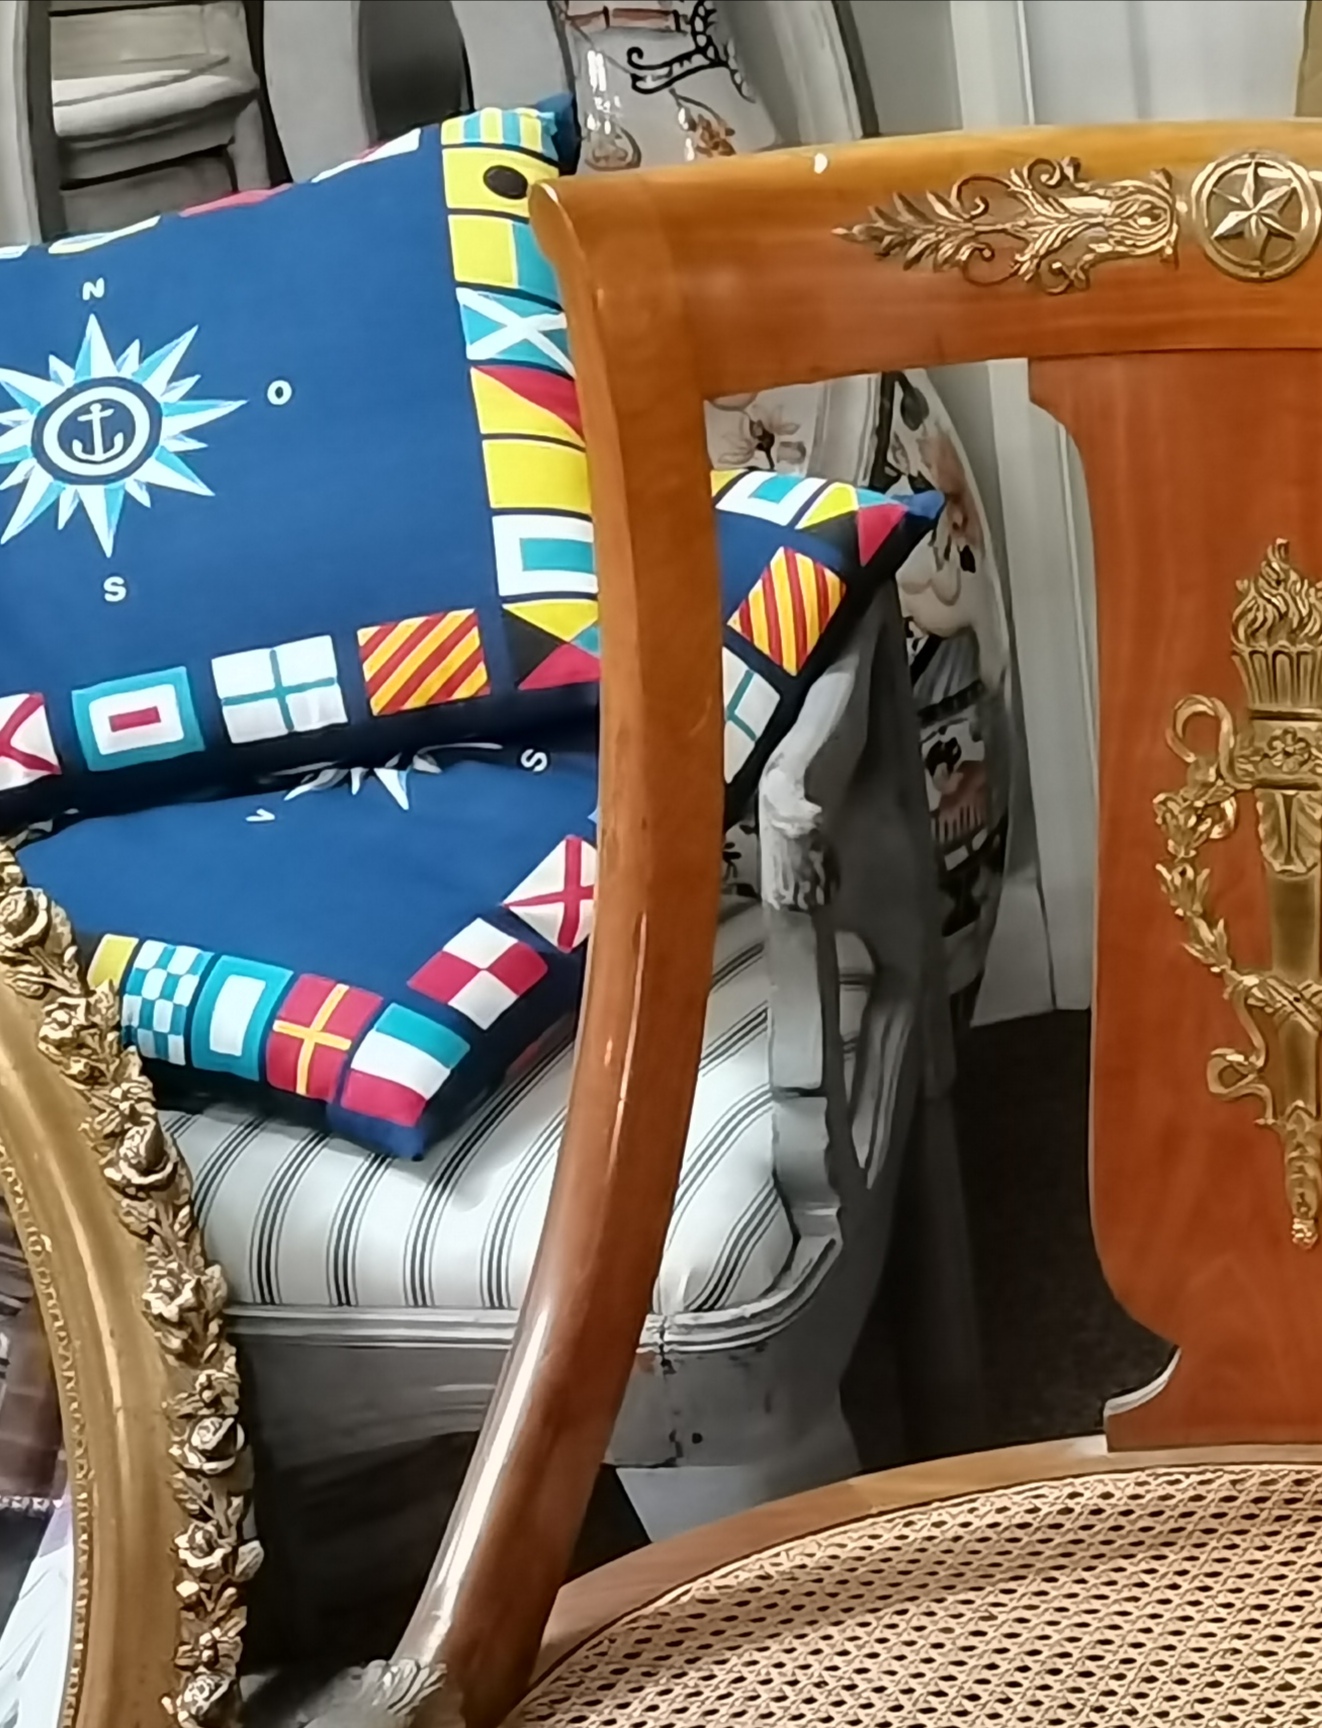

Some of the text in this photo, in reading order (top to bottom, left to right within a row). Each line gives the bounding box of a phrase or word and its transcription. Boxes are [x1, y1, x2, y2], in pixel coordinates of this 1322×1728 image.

[82, 277, 105, 300] N
[103, 576, 127, 602] S
[520, 748, 548, 772] S
